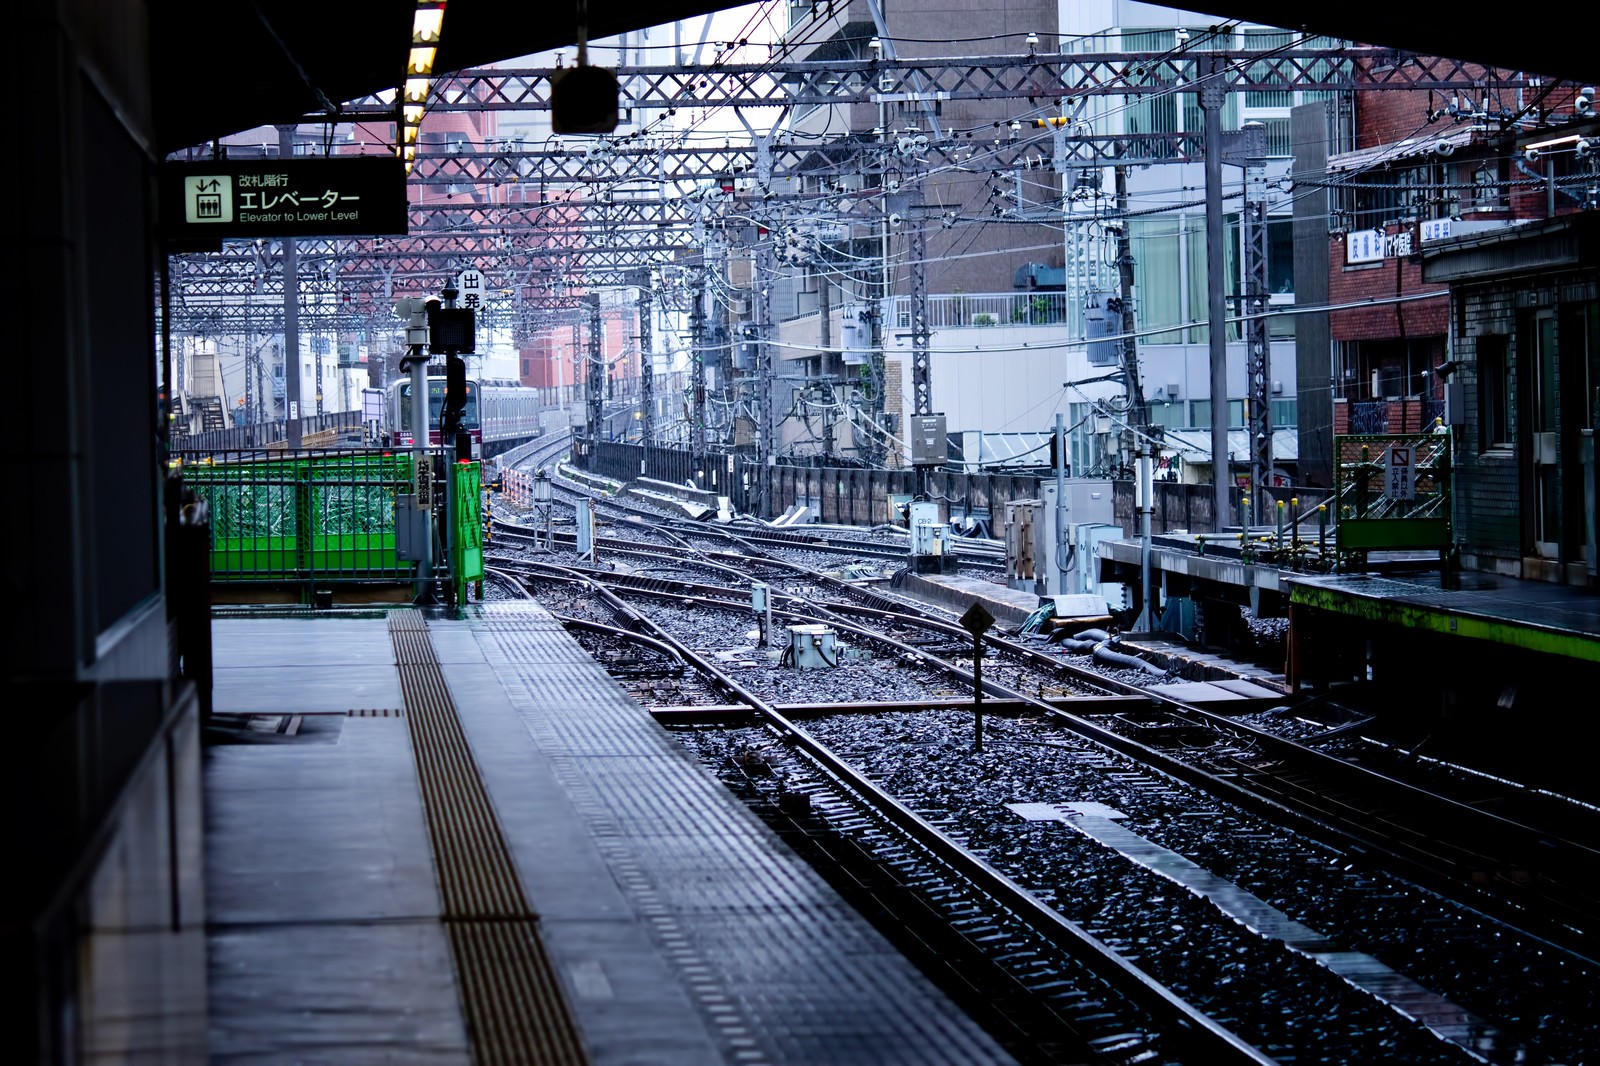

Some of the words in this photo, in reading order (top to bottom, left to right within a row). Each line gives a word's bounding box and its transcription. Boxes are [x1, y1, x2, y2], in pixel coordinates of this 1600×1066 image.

[239, 174, 288, 187] 改札階行
[240, 189, 360, 209] エレベーター
[240, 212, 281, 222] Elevator
[284, 213, 294, 221] to
[297, 211, 328, 221] Lower
[331, 210, 358, 220] Level
[464, 273, 480, 308] 出発
[970, 611, 984, 631] 8
